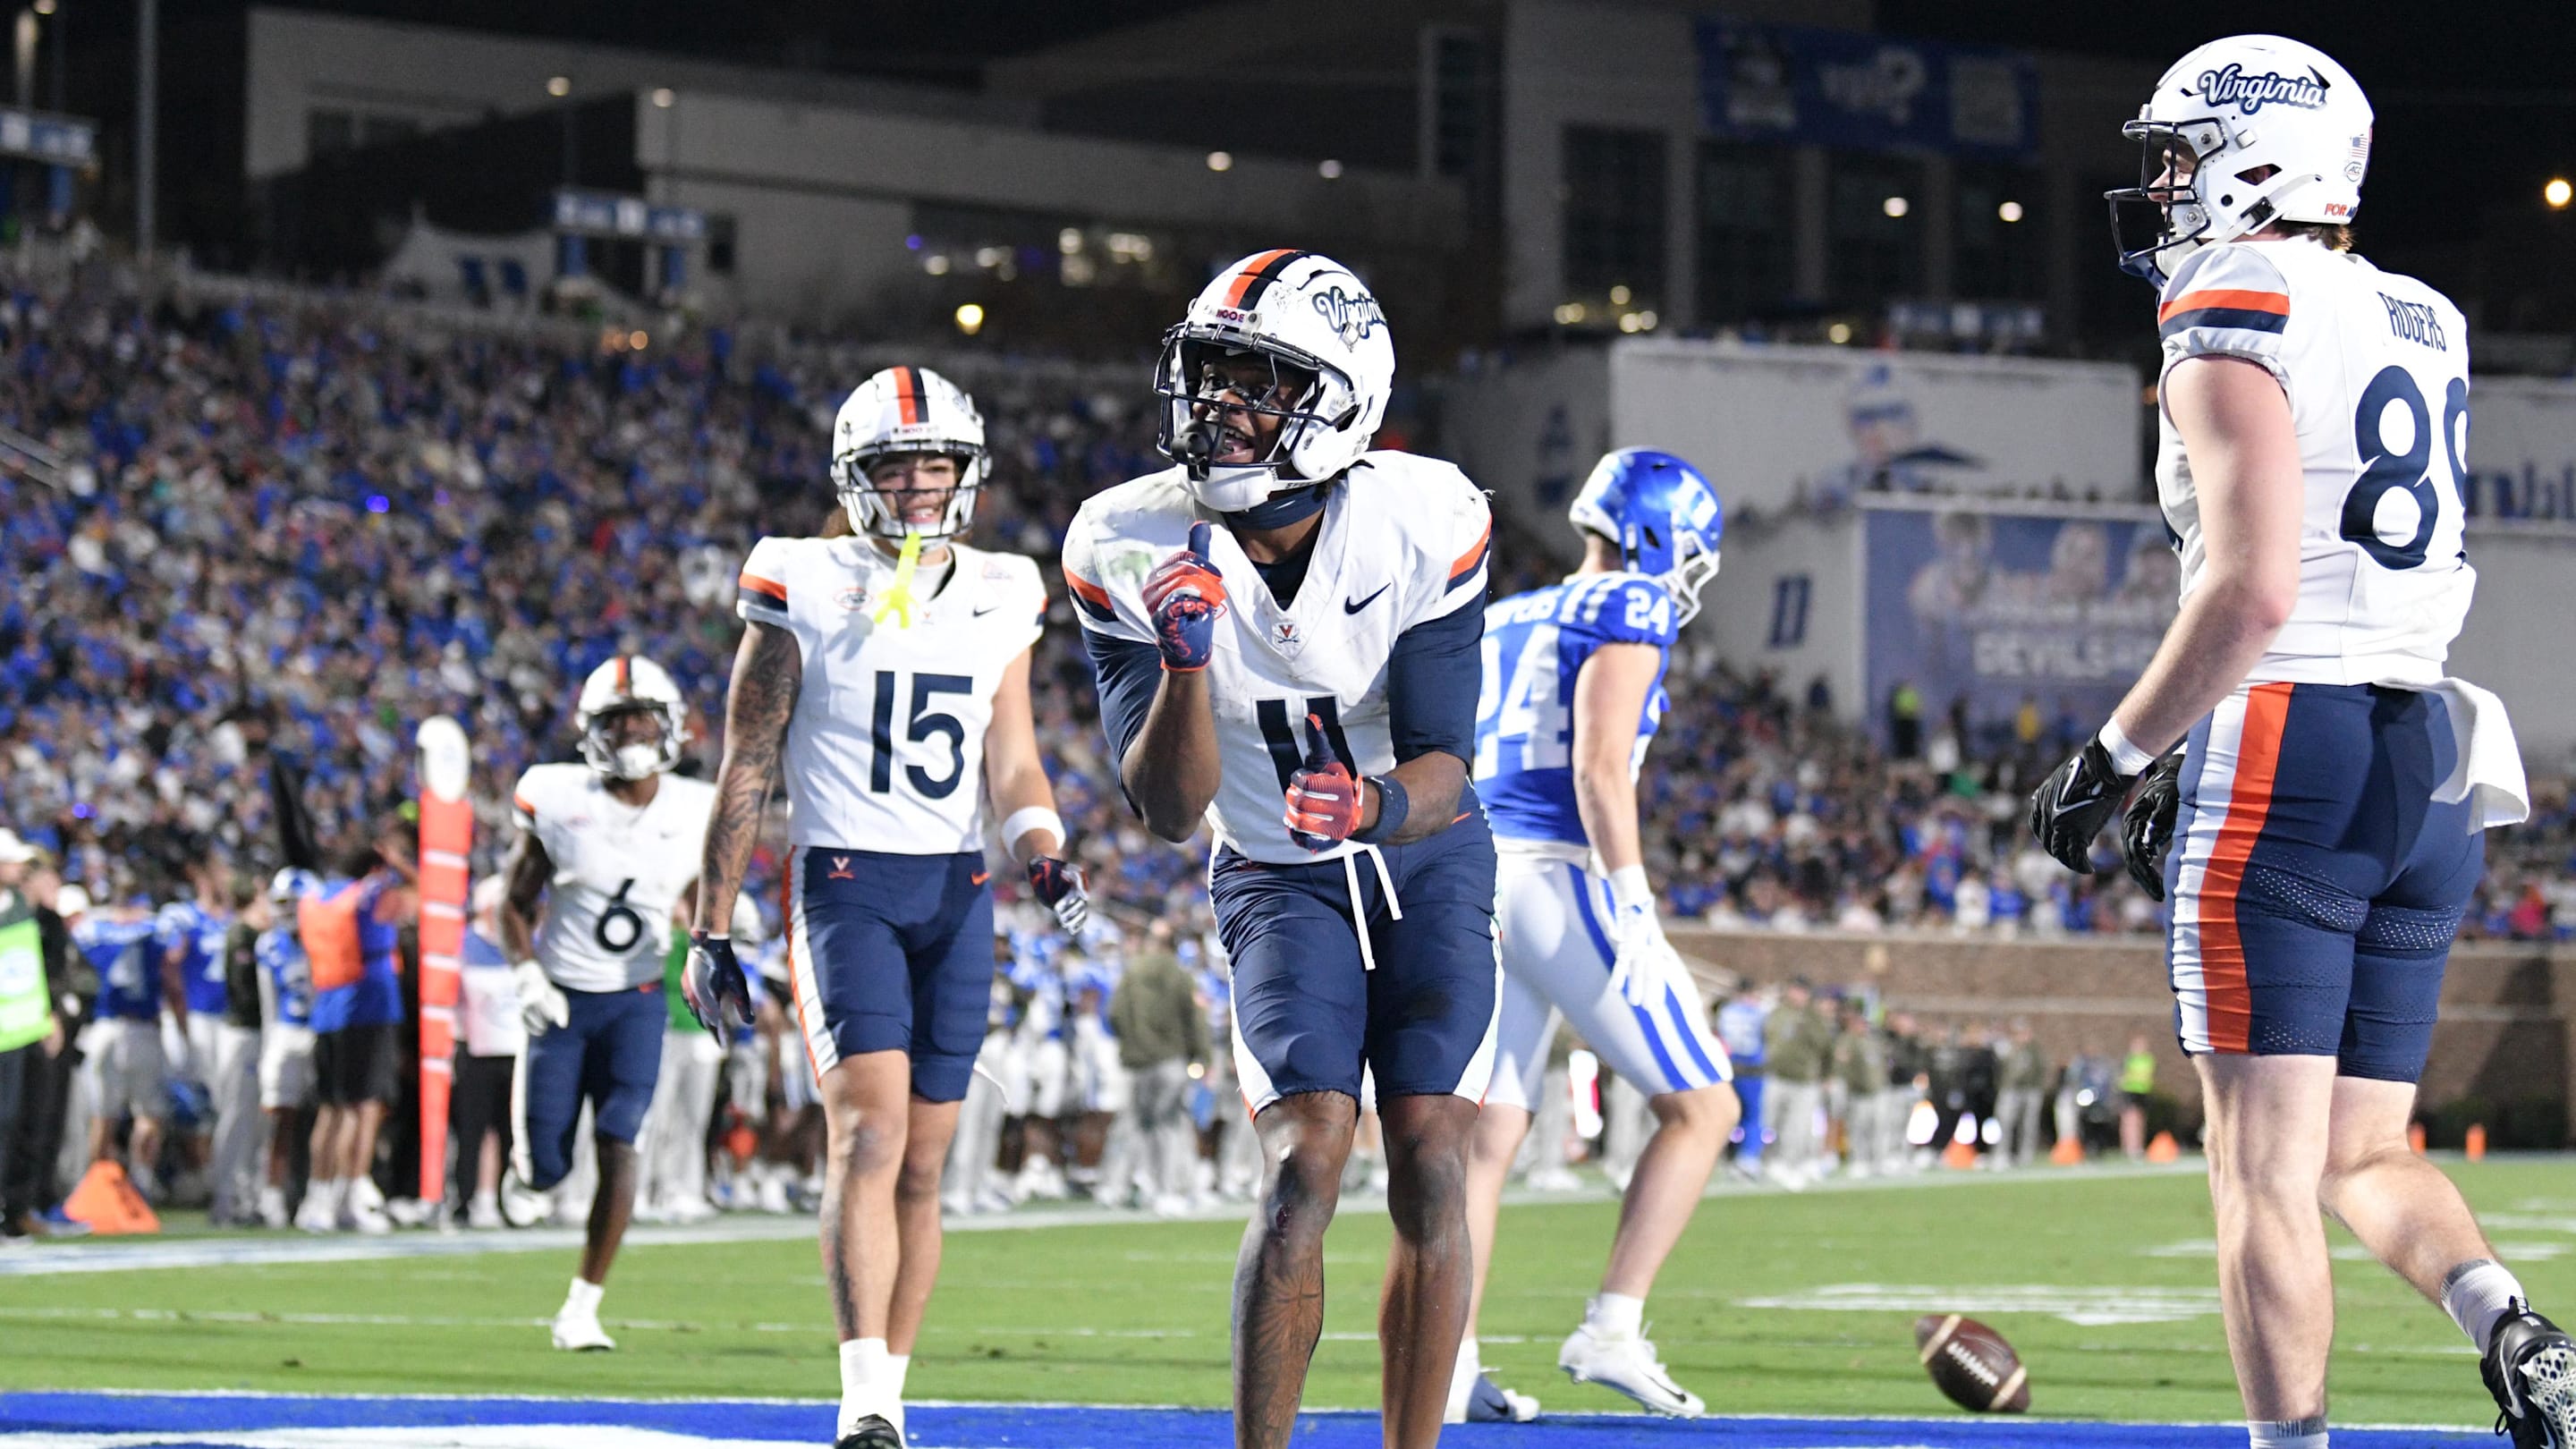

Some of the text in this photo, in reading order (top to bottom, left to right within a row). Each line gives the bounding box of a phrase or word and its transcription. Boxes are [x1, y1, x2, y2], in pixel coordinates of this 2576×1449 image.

[2198, 64, 2326, 114] Virginia
[2325, 203, 2347, 216] FOR
[2377, 291, 2447, 352] ROGERS
[1625, 587, 1670, 636] 24
[870, 670, 973, 800] 15
[597, 878, 642, 952] 6
